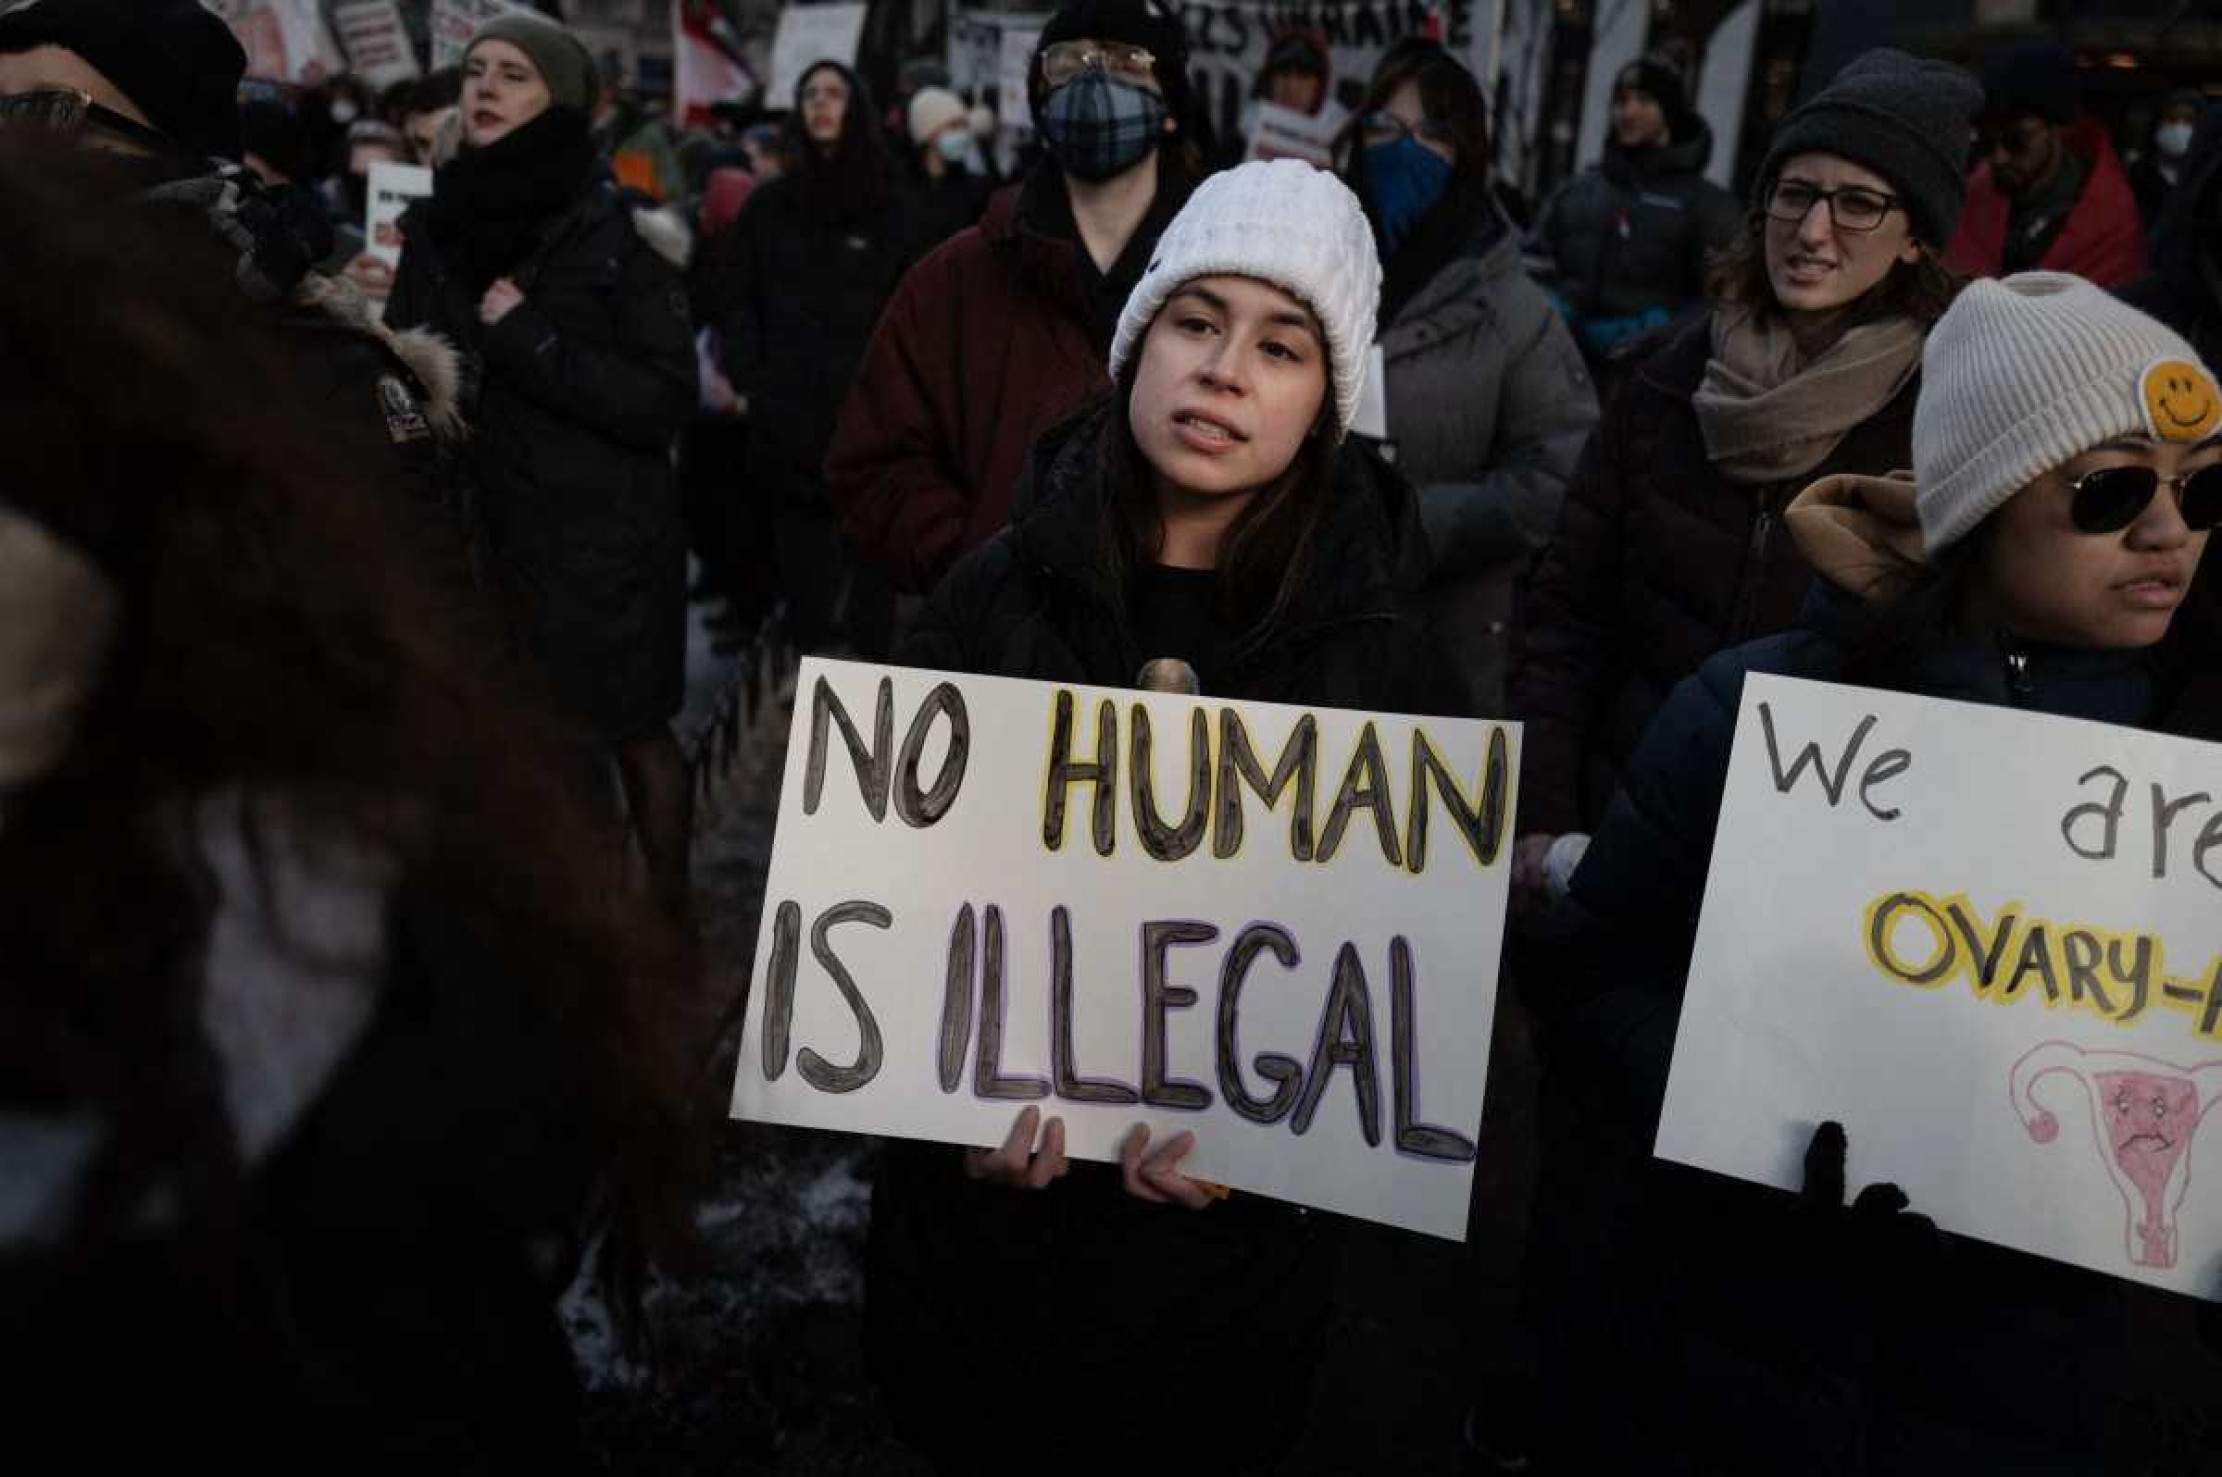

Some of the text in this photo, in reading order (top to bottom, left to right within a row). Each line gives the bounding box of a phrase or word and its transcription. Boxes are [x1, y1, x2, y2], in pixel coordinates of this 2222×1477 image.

[804, 676, 1506, 874] NO HUMAN
[1759, 702, 1911, 820] We
[762, 901, 1476, 1162] IS ILLEGAL
[1869, 892, 2222, 1034] OVARY-
